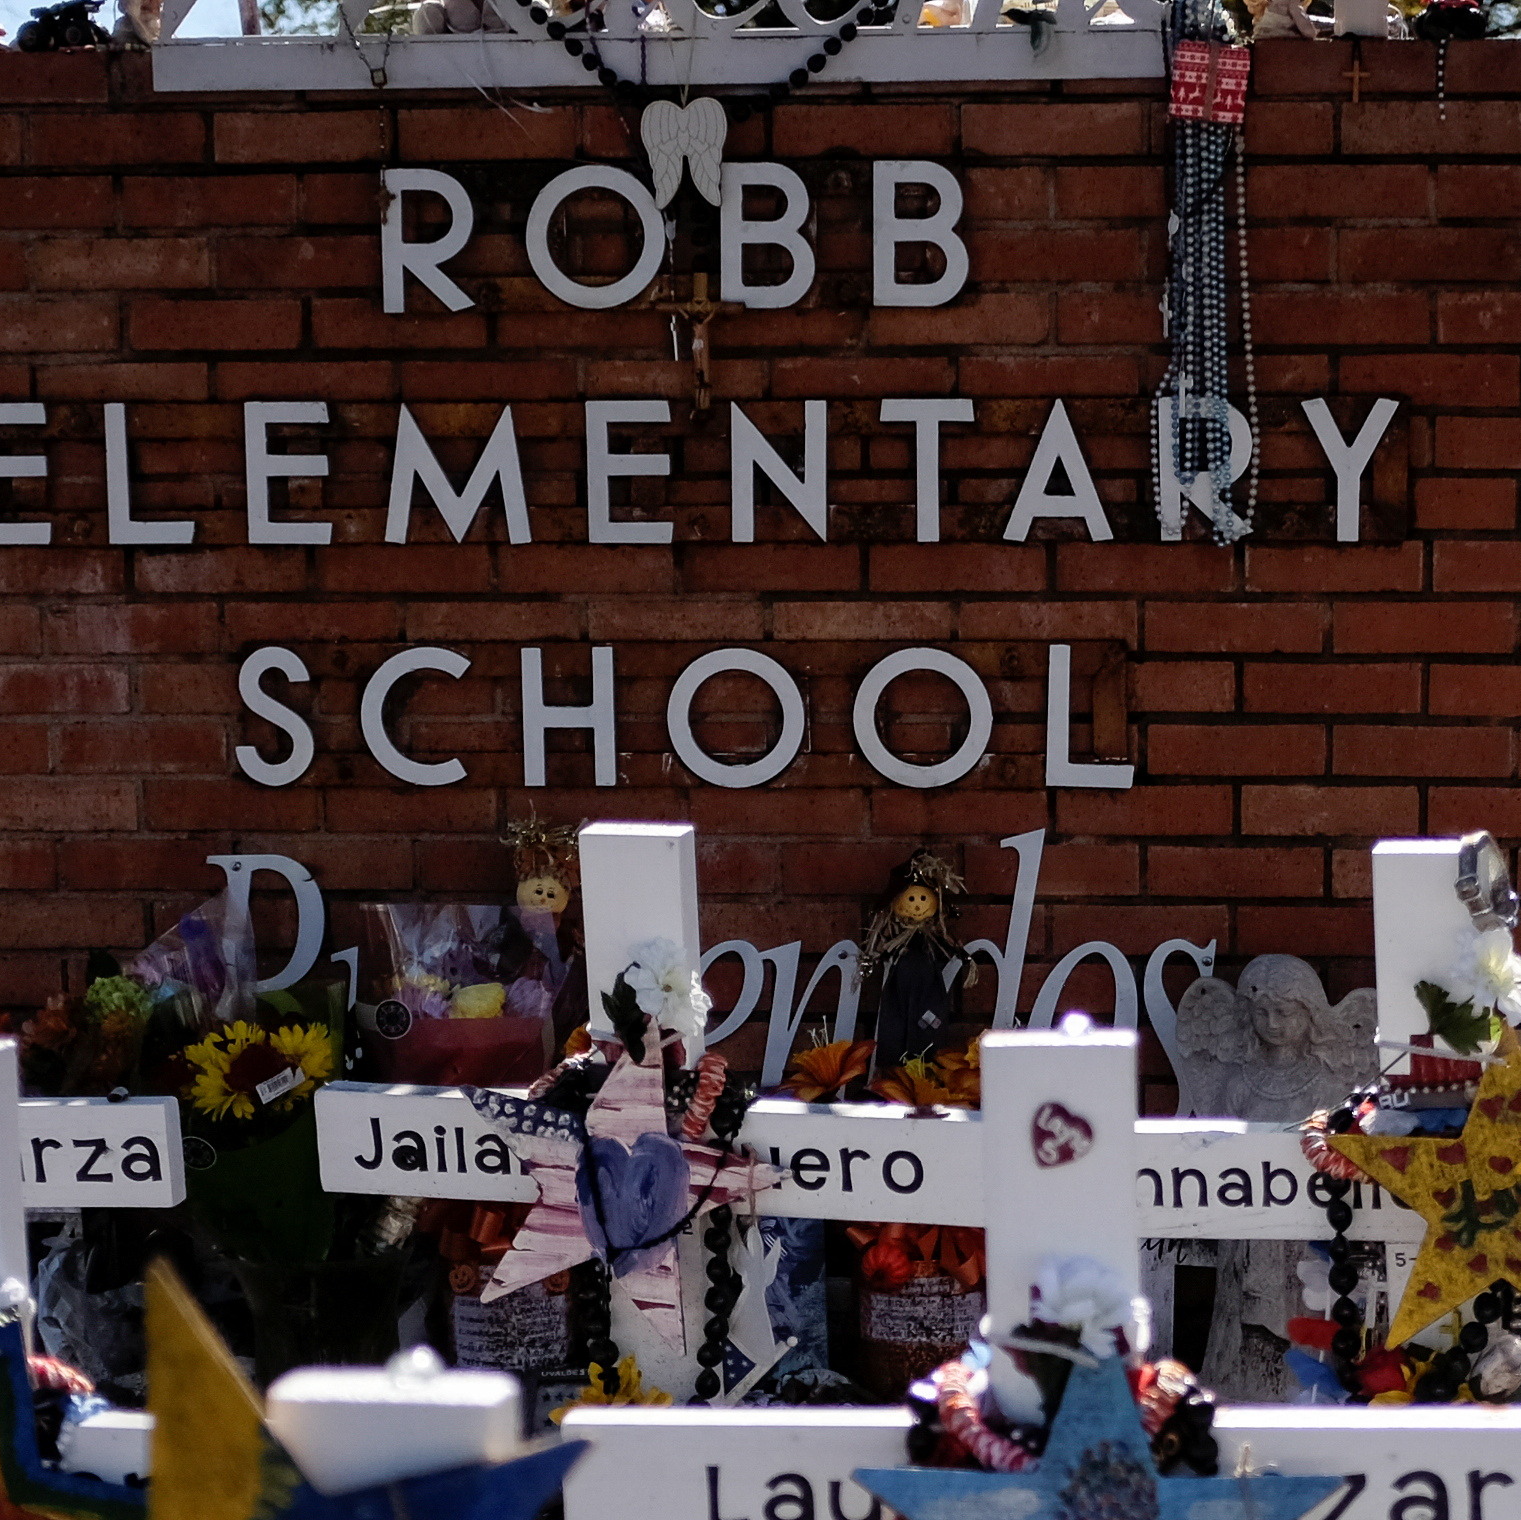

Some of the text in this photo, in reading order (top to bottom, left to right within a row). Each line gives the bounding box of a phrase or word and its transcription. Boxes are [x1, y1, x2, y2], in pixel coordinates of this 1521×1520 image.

[382, 161, 969, 314] ROBB
[236, 644, 1134, 788] SCHOOL
[20, 1135, 163, 1183] rza
[354, 1117, 530, 1176] Jaila
